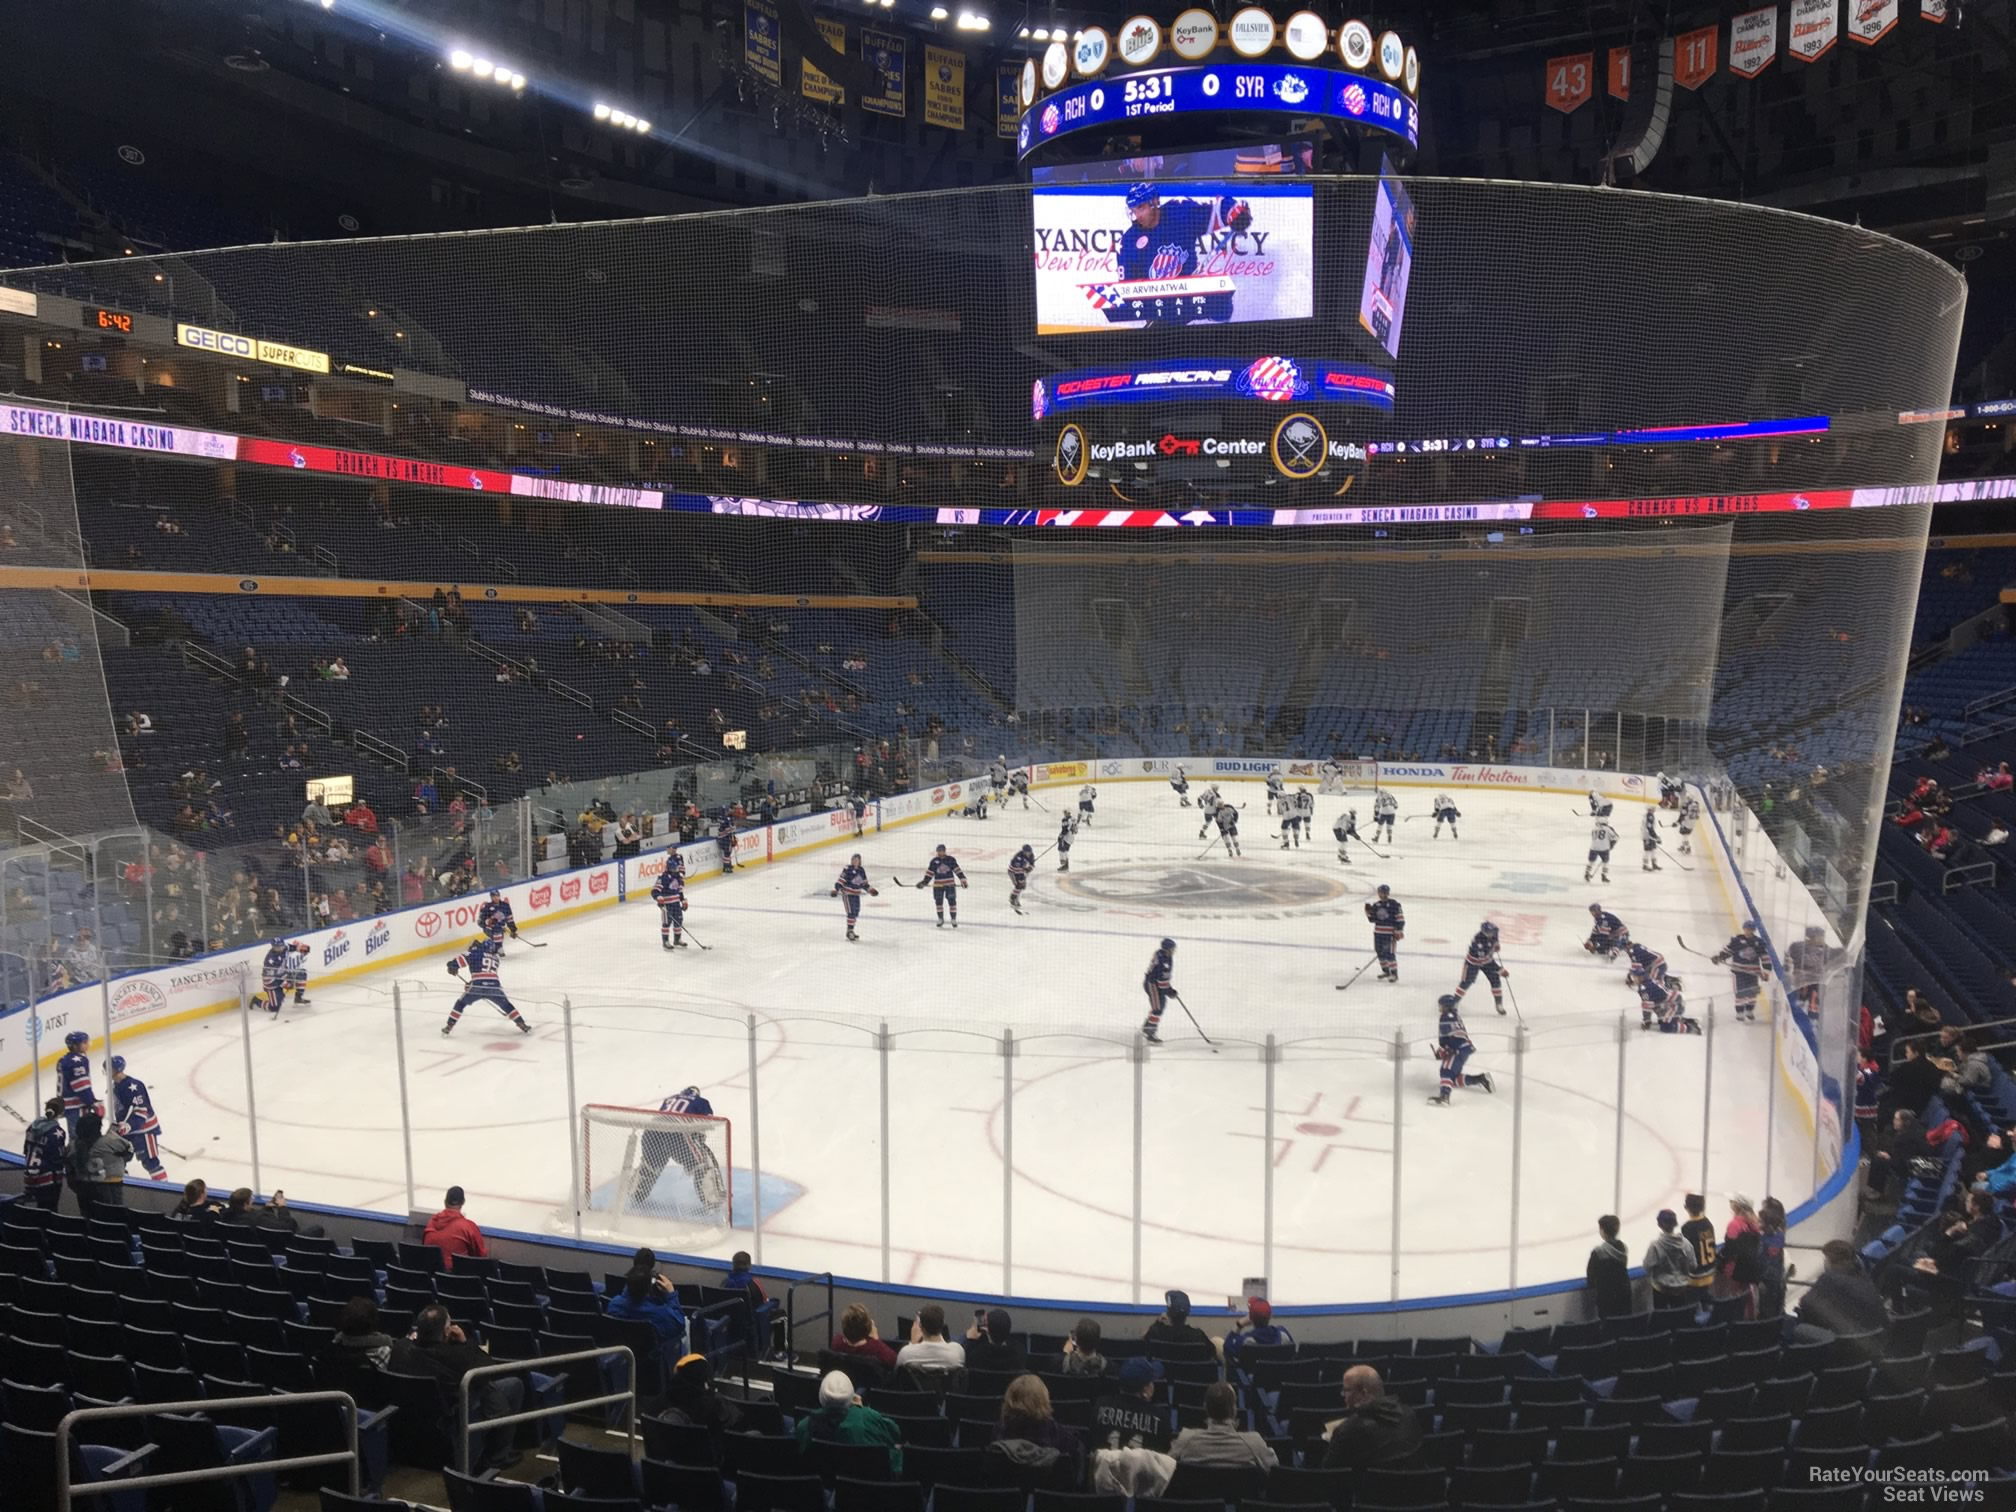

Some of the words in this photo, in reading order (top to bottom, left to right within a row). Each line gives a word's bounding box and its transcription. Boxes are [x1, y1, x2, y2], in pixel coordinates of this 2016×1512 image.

[1176, 25, 1213, 35] KeyBank
[1737, 20, 1771, 34] CHAMPIONS
[1863, 21, 1882, 34] 1996
[749, 29, 777, 50] SABRES
[1125, 30, 1153, 56] Blue
[1803, 40, 1821, 53] 1993
[928, 51, 964, 68] BUFFALO
[1687, 38, 1706, 72] 11
[1743, 57, 1761, 69] 1992
[930, 81, 961, 96] SABRES
[1124, 76, 1172, 102] 5:31
[1202, 73, 1220, 96] 0
[1235, 75, 1264, 98] SYR
[1552, 63, 1586, 96] 43
[1065, 96, 1085, 121] RCH
[1090, 88, 1104, 110] 0
[1126, 104, 1142, 117] 1ST
[1144, 99, 1175, 114] Period
[1373, 93, 1390, 116] RCH
[1393, 98, 1402, 119] 0
[1206, 253, 1274, 276] Cheese
[1120, 286, 1130, 295] 38
[1133, 284, 1158, 294] ARVIN
[1160, 283, 1188, 292] ATWAL
[1220, 280, 1226, 288] D
[98, 311, 131, 331] 6:42
[185, 328, 250, 355] GEICO
[262, 345, 322, 368] SUPERCUTS
[1057, 374, 1131, 395] ROCHESTER
[1135, 370, 1232, 385] AMERICANS
[1325, 372, 1386, 392] ROCHESTER
[11, 410, 62, 437] SENECA
[70, 417, 125, 444] NIAGARA
[131, 426, 174, 449] CASINO
[1091, 440, 1157, 461] KeyBank
[1203, 437, 1266, 454] Center
[1397, 442, 1406, 452] 0
[1422, 440, 1448, 451] 5:31
[1466, 439, 1475, 449] 0
[1481, 438, 1494, 448] SYR
[954, 510, 964, 523] VS
[1361, 508, 1395, 522] SENECA
[1400, 507, 1440, 521] NIAGARA
[1444, 506, 1478, 519] CASINO
[1216, 762, 1241, 771] BUD
[1242, 763, 1278, 772] LIGHT
[1383, 767, 1445, 777] HONDA
[1451, 767, 1475, 781] Tim
[1477, 768, 1528, 784] Hortons
[365, 928, 391, 956] Blue
[323, 938, 351, 967] Blue
[170, 969, 217, 988] YANCEY'S
[139, 982, 162, 1002] FANCY
[45, 1012, 69, 1032] AT&T
[132, 1096, 143, 1105] 45
[663, 1099, 690, 1113] 30
[1098, 1406, 1160, 1435] PERREAULT
